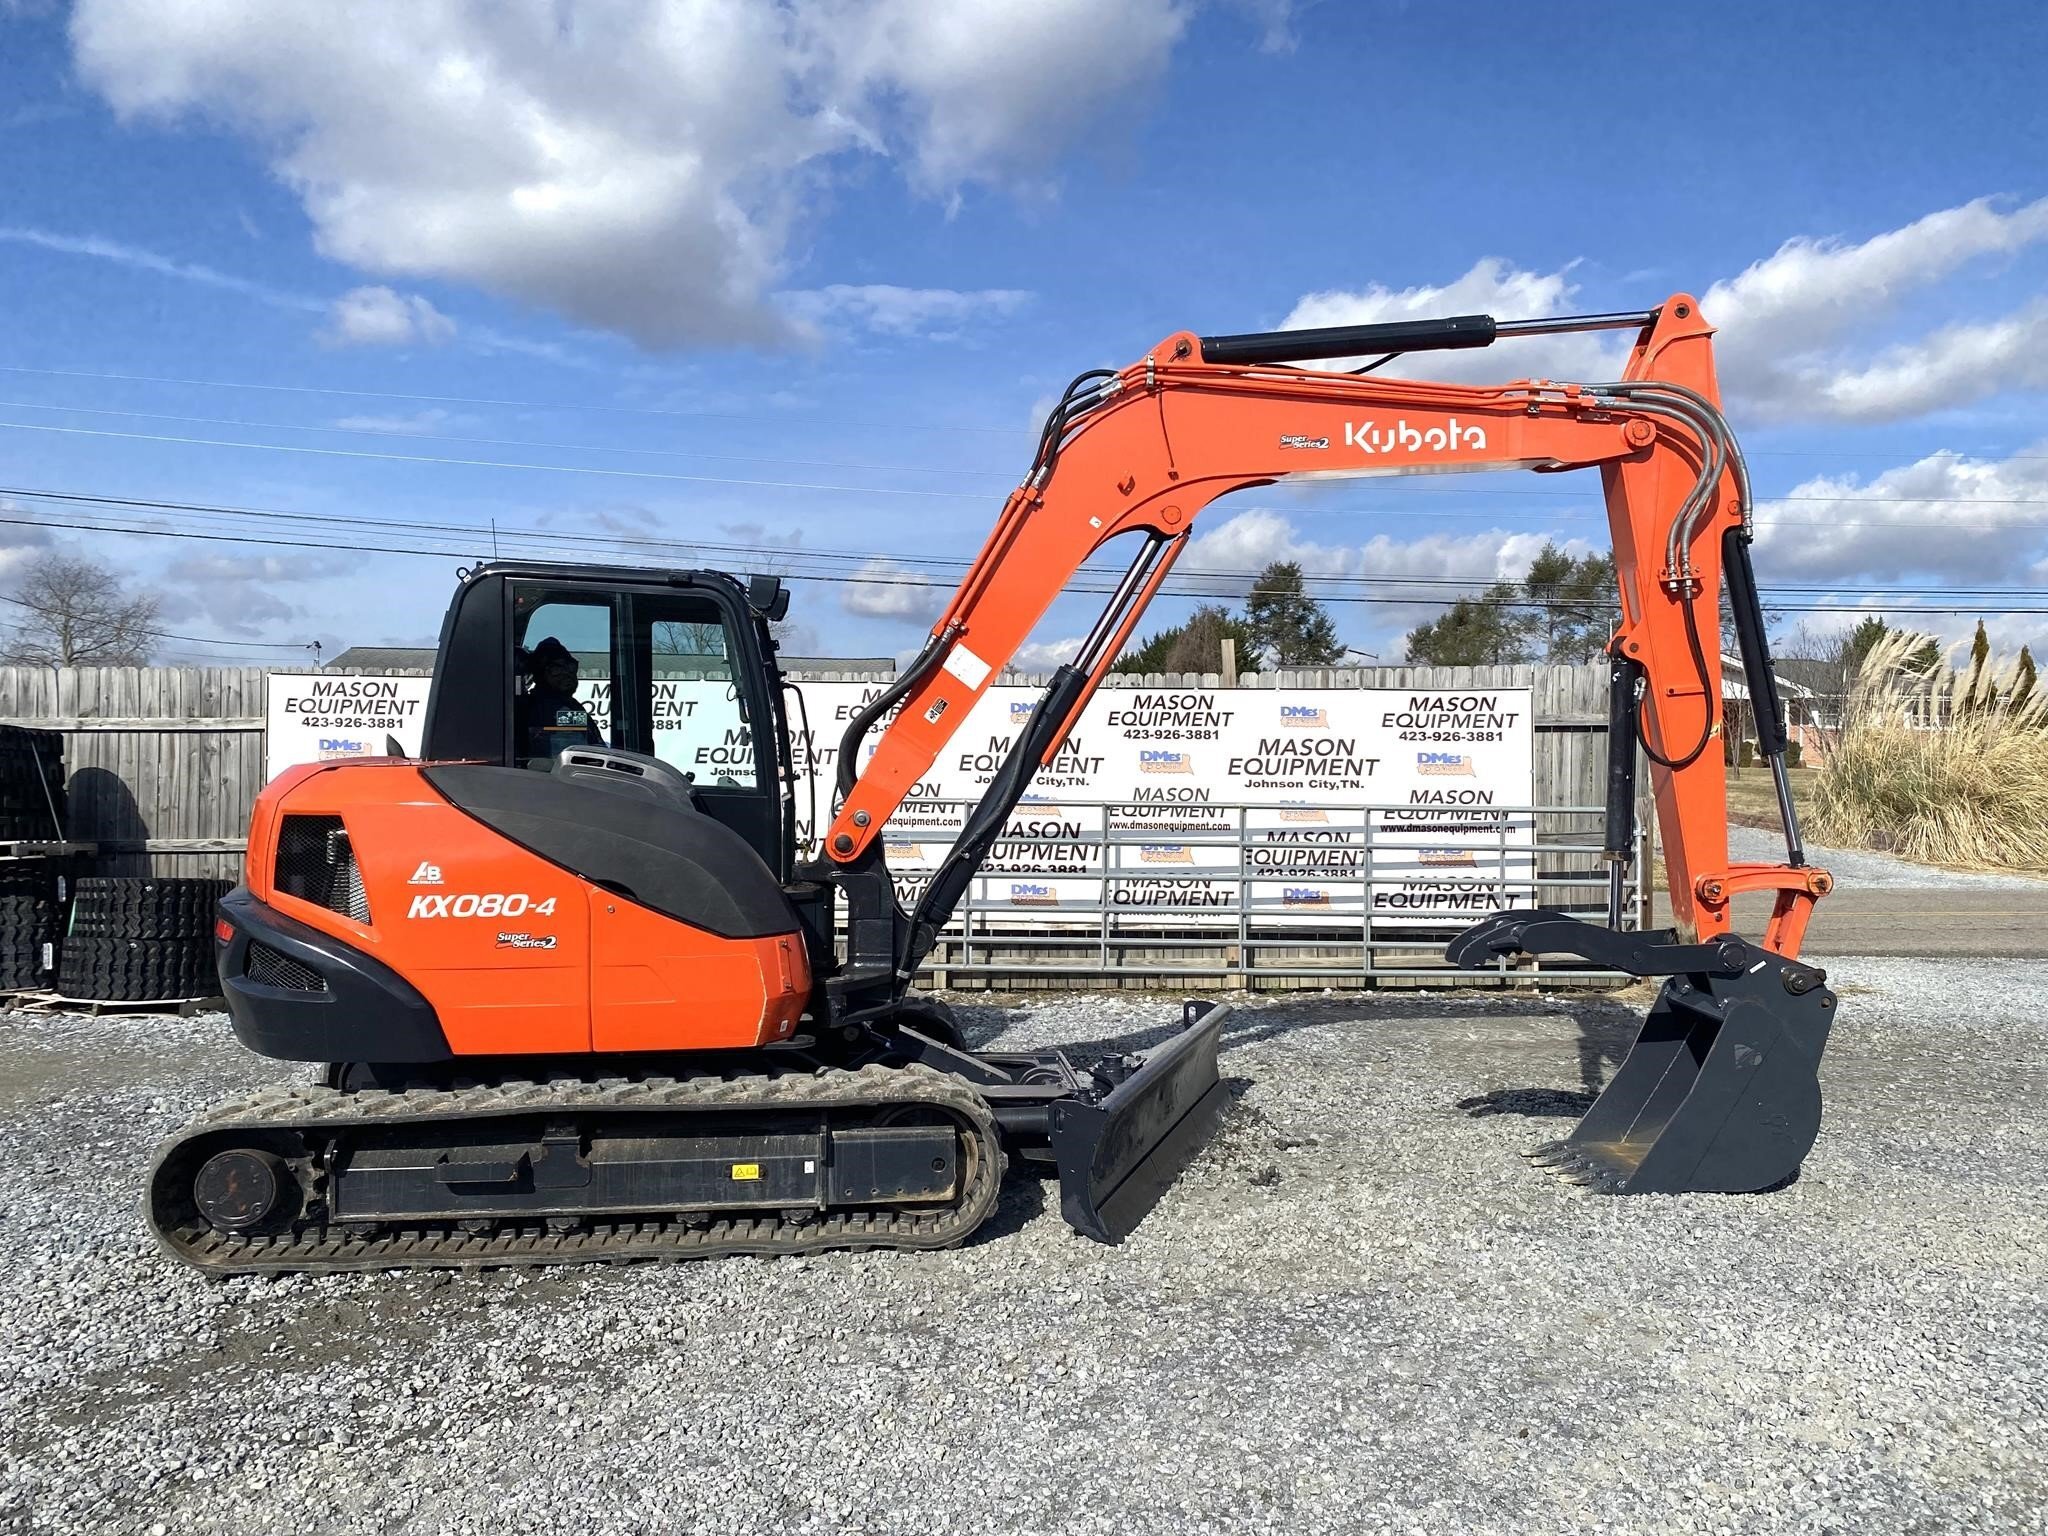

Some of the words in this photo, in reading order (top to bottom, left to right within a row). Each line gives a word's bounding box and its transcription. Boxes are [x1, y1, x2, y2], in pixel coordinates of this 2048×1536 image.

[1281, 435, 1308, 444] Super
[1345, 418, 1487, 454] Kubota
[312, 681, 398, 698] MASON
[285, 698, 420, 715] EQUIPMENT
[1133, 694, 1214, 710] MASON
[1409, 696, 1497, 712] MASON
[302, 717, 404, 729] 423-926-3881
[1108, 711, 1234, 727] EQUIPMENT
[1382, 713, 1519, 729] EQUIPMENT
[1123, 729, 1219, 740] 423-926-3881
[1398, 731, 1503, 742] 423-926-3881
[1258, 738, 1356, 756] MASON
[694, 747, 838, 765] EQUIENT
[1228, 758, 1380, 776] EQUIPMENT
[1244, 779, 1304, 788] Johnson
[1308, 779, 1364, 790] City,TN.
[1133, 787, 1210, 801] MASON
[1409, 790, 1494, 804] MASON
[1380, 823, 1516, 835] www.dmasonequipment.cm
[407, 893, 557, 918] KX080-4
[498, 932, 530, 943] Super
